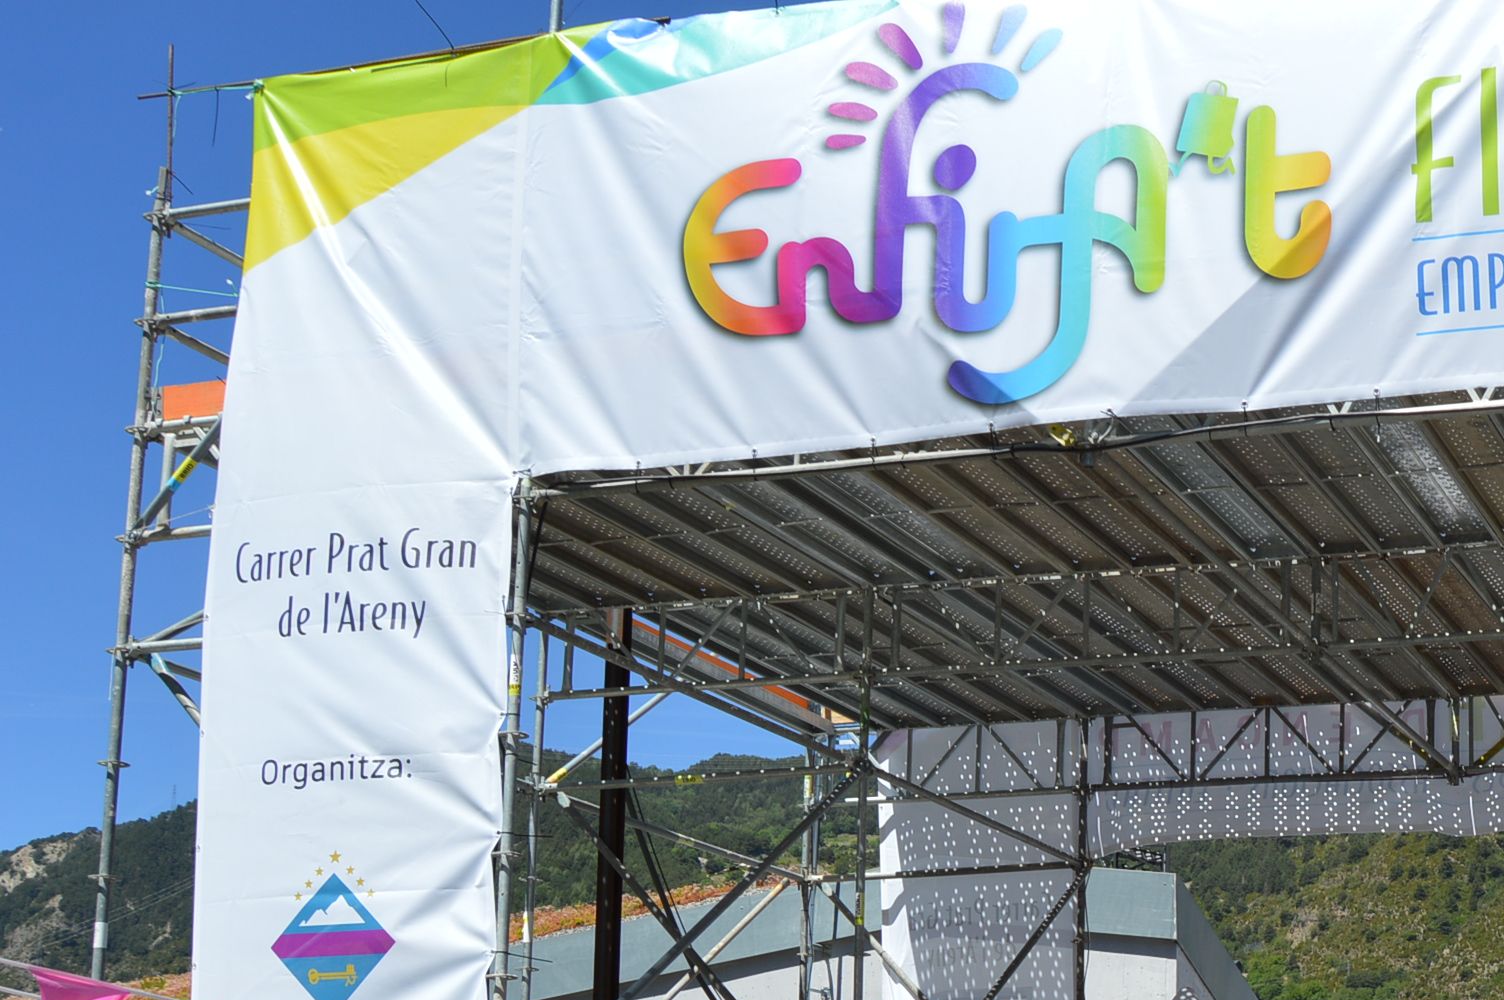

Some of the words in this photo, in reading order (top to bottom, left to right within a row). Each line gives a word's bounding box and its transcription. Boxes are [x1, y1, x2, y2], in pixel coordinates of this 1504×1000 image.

[236, 542, 317, 584] Carrer
[327, 532, 390, 574] Prat
[401, 527, 478, 569] Gran
[278, 595, 311, 638] de
[322, 590, 427, 639] l'Areny
[261, 754, 412, 790] Organitza:
